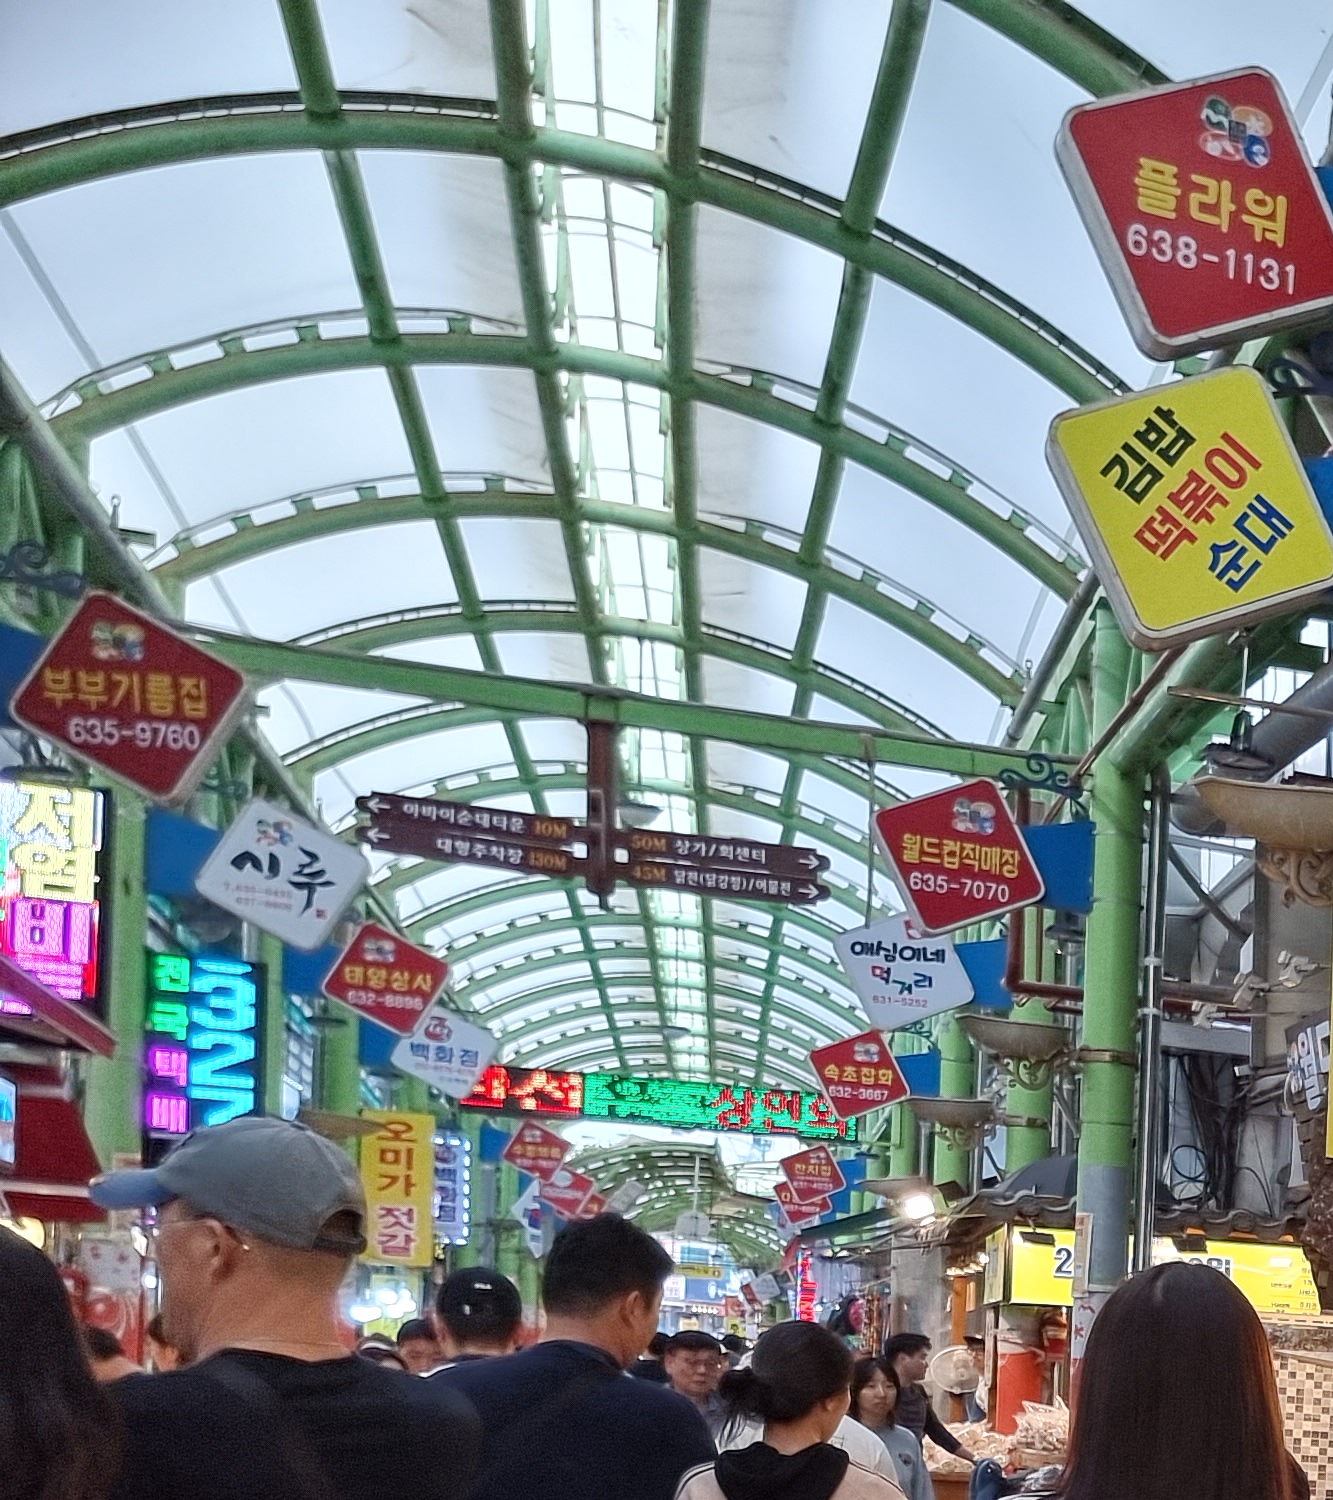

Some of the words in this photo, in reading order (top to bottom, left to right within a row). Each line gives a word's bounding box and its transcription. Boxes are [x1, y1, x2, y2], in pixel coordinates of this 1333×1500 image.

[1134, 157, 1288, 247] 플라워
[1126, 223, 1296, 295] 638-1131
[1100, 406, 1198, 504] 김밥
[1134, 431, 1262, 562] 떡볶이
[1206, 494, 1295, 593] 순대
[42, 668, 208, 719] 부부기름집
[67, 717, 201, 751] 635-9760
[402, 802, 526, 836] 아바이순대타운
[533, 819, 568, 838] 10M
[436, 837, 525, 866] 대형주차장
[631, 835, 667, 854] 50M
[901, 832, 1020, 880] 월드컵직매장
[631, 865, 667, 883] 45M
[909, 871, 1010, 903] 635-7070
[343, 965, 433, 993] 태양상사
[870, 965, 933, 996] 먹거리
[824, 1063, 894, 1087] 속초잡화
